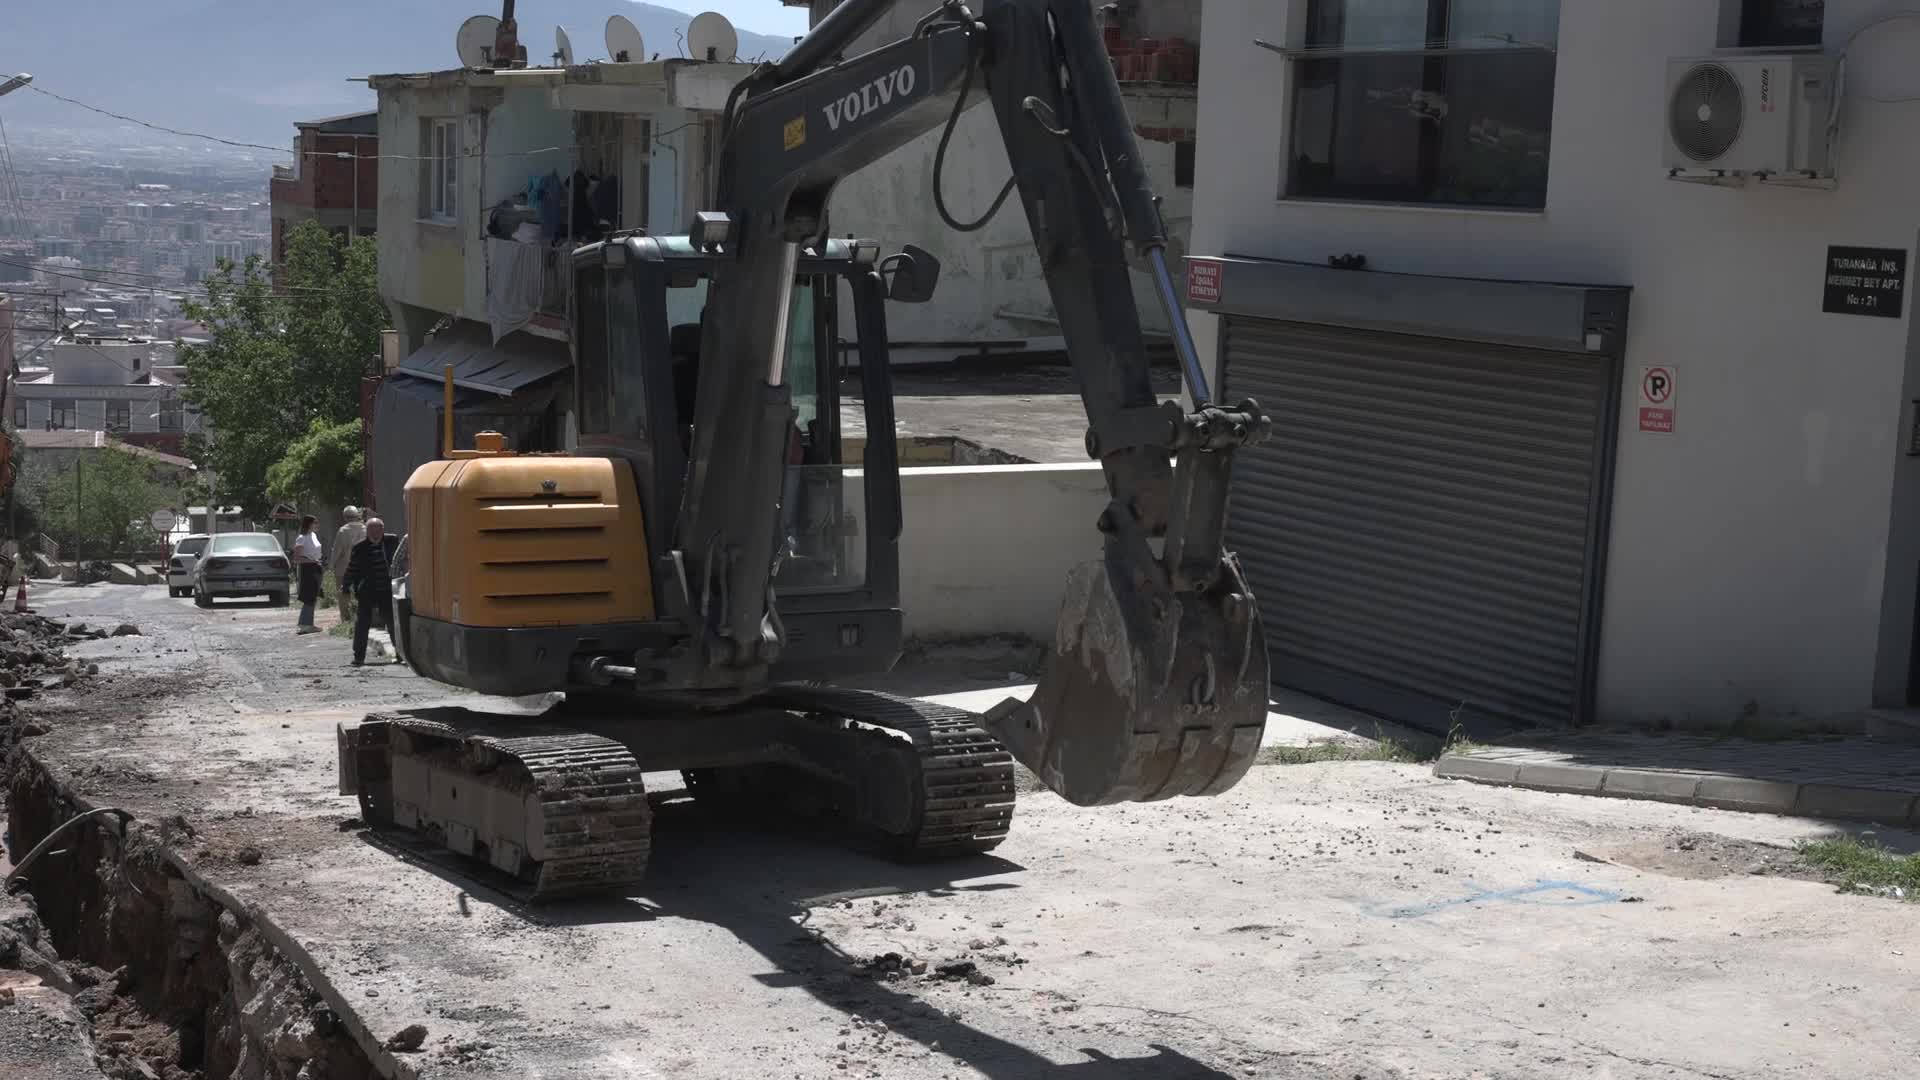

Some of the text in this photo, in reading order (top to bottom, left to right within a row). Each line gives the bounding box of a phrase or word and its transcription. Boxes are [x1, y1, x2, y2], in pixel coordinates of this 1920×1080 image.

[822, 64, 915, 130] VOLVO
[1828, 275, 1862, 287] MEHMET
[1863, 277, 1881, 288] BEY
